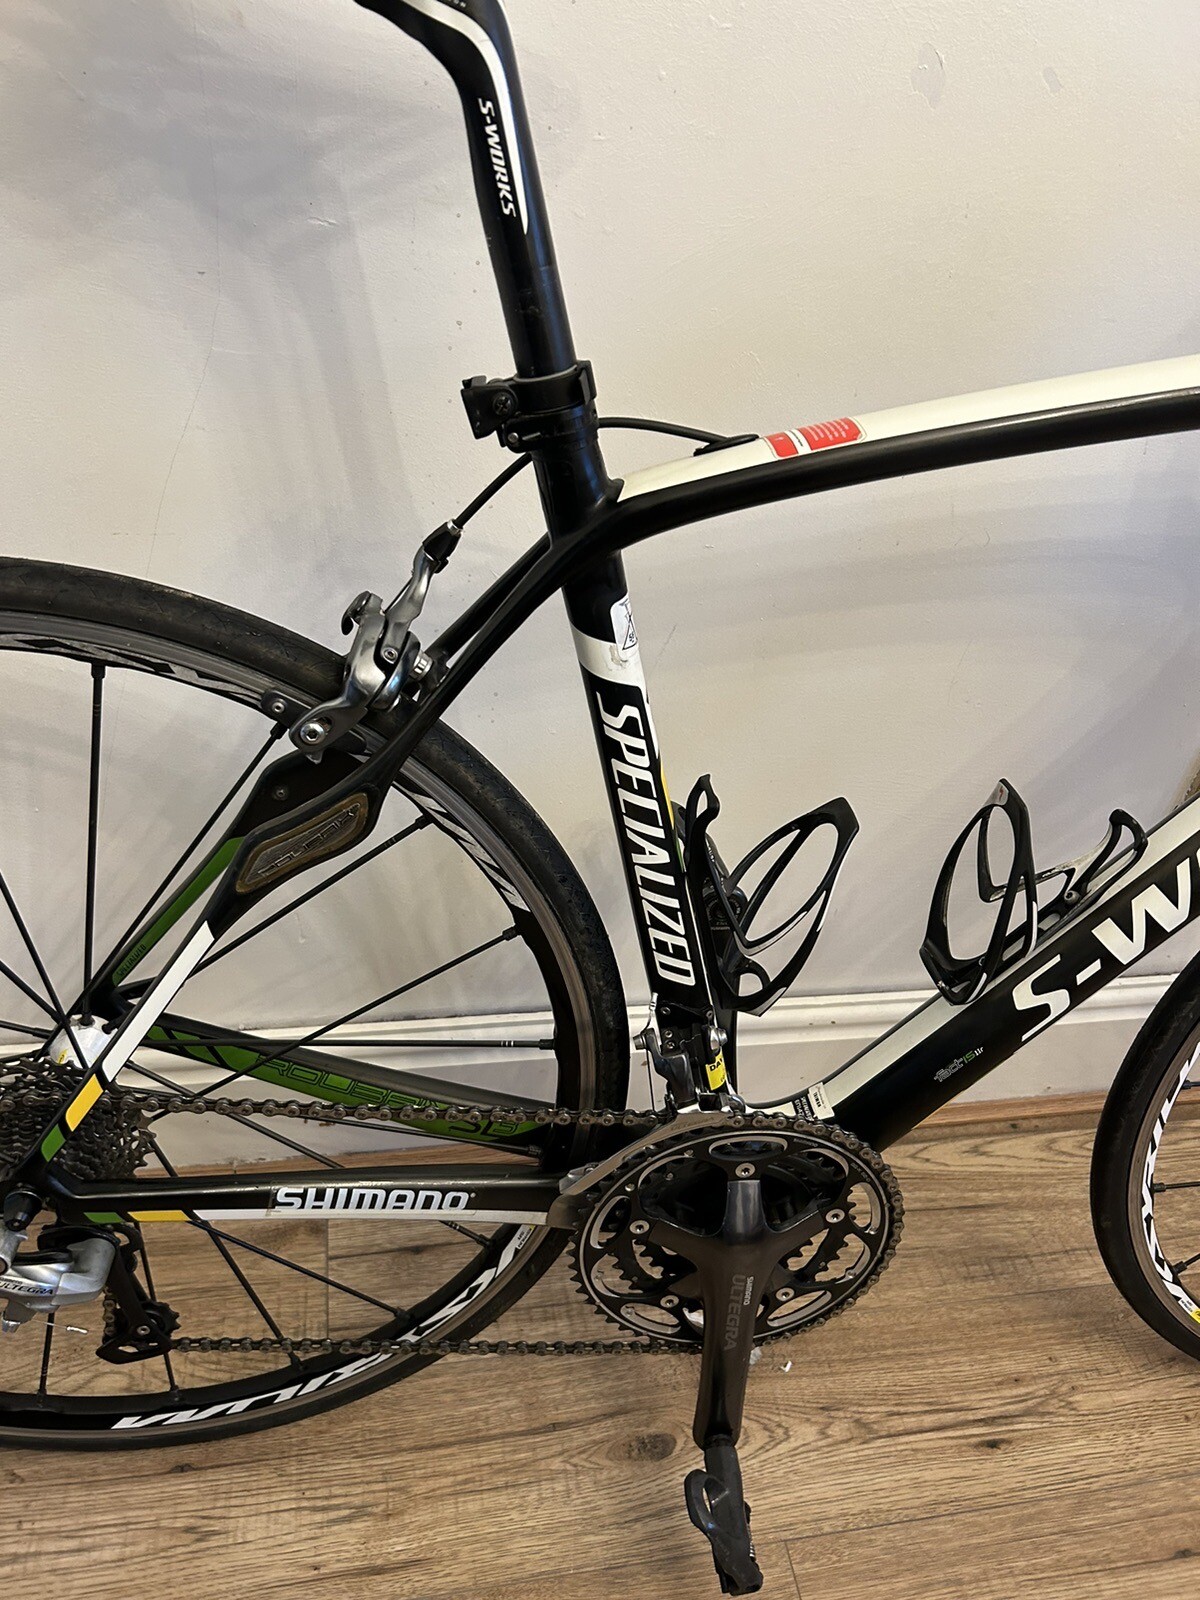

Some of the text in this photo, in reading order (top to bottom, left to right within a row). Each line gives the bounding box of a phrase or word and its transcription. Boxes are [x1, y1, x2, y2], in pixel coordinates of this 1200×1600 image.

[478, 97, 517, 218] S-WORKS
[596, 691, 696, 987] SPECIALIZED
[1012, 847, 1200, 1042] S-W
[274, 1186, 470, 1210] SHIMANO
[723, 1274, 748, 1351] ULTEGRA
